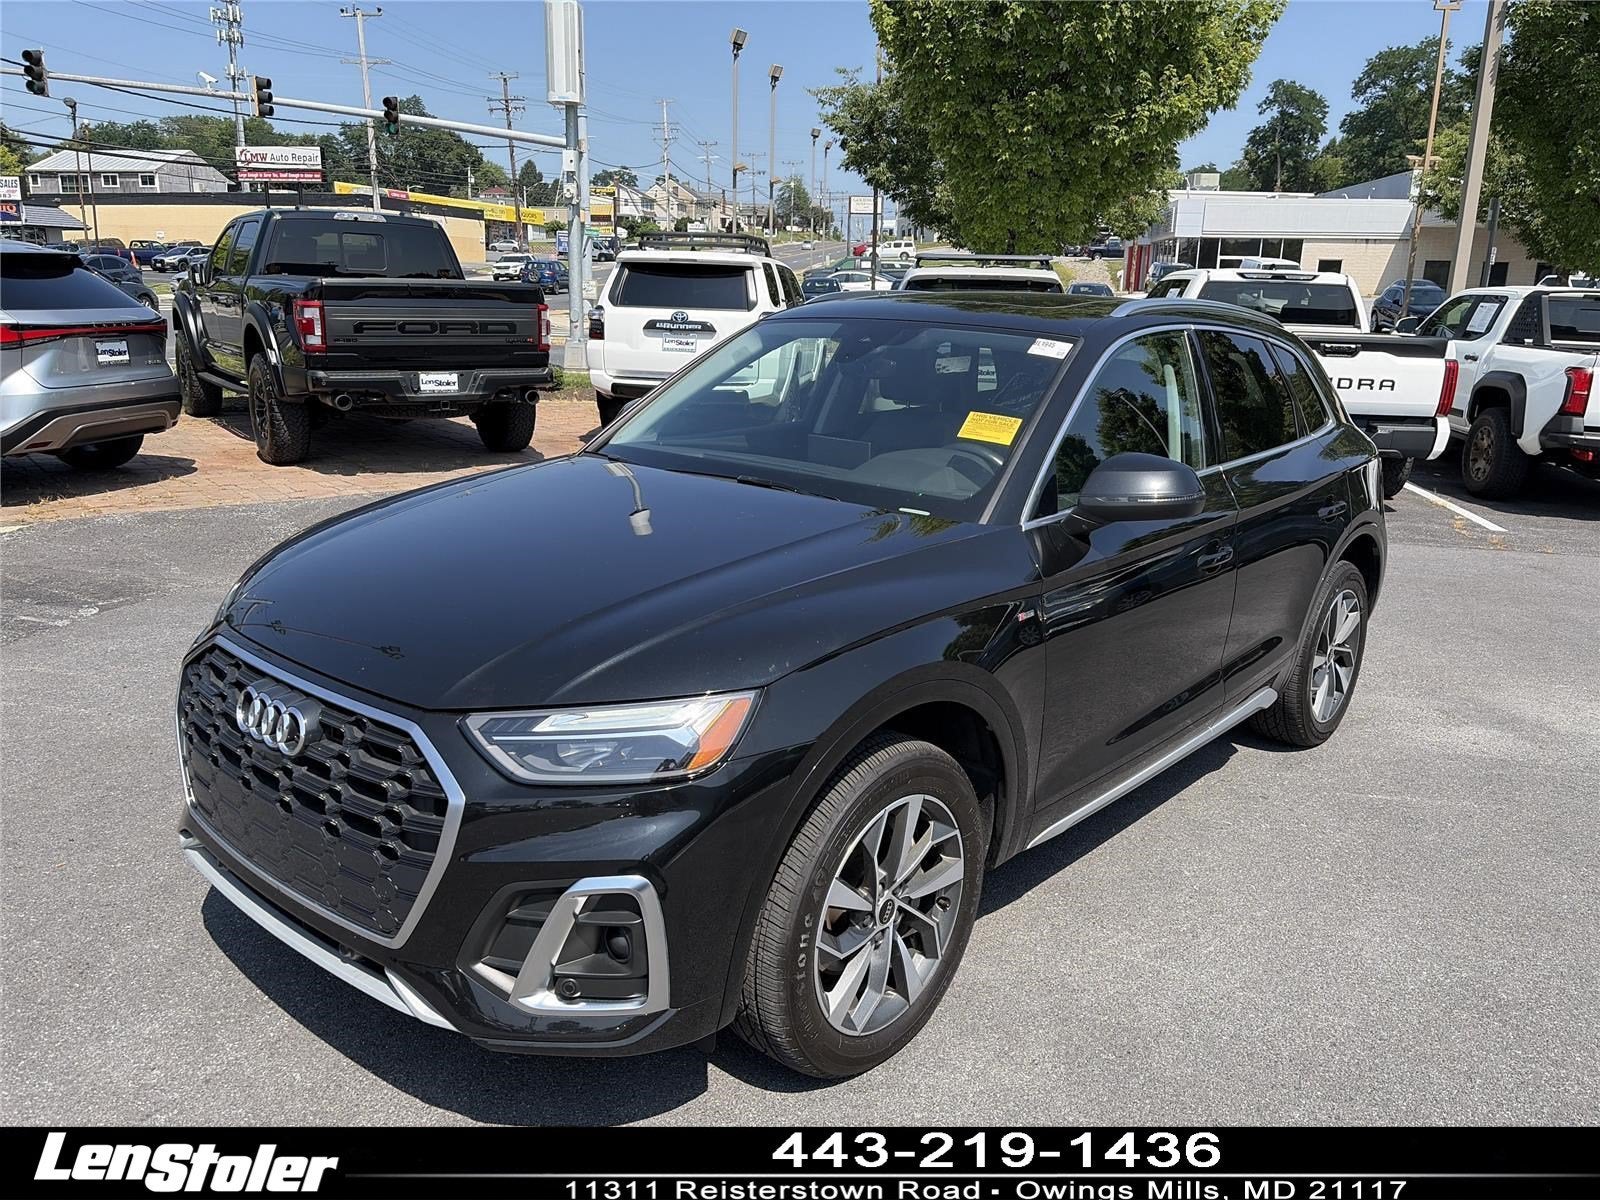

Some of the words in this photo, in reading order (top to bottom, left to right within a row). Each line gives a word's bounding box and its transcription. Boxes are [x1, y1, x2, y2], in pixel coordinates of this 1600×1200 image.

[244, 153, 268, 162] LMW
[270, 153, 289, 162] Auto
[291, 153, 319, 164] Repair
[353, 320, 517, 335] FORD
[1328, 377, 1396, 391] DRA
